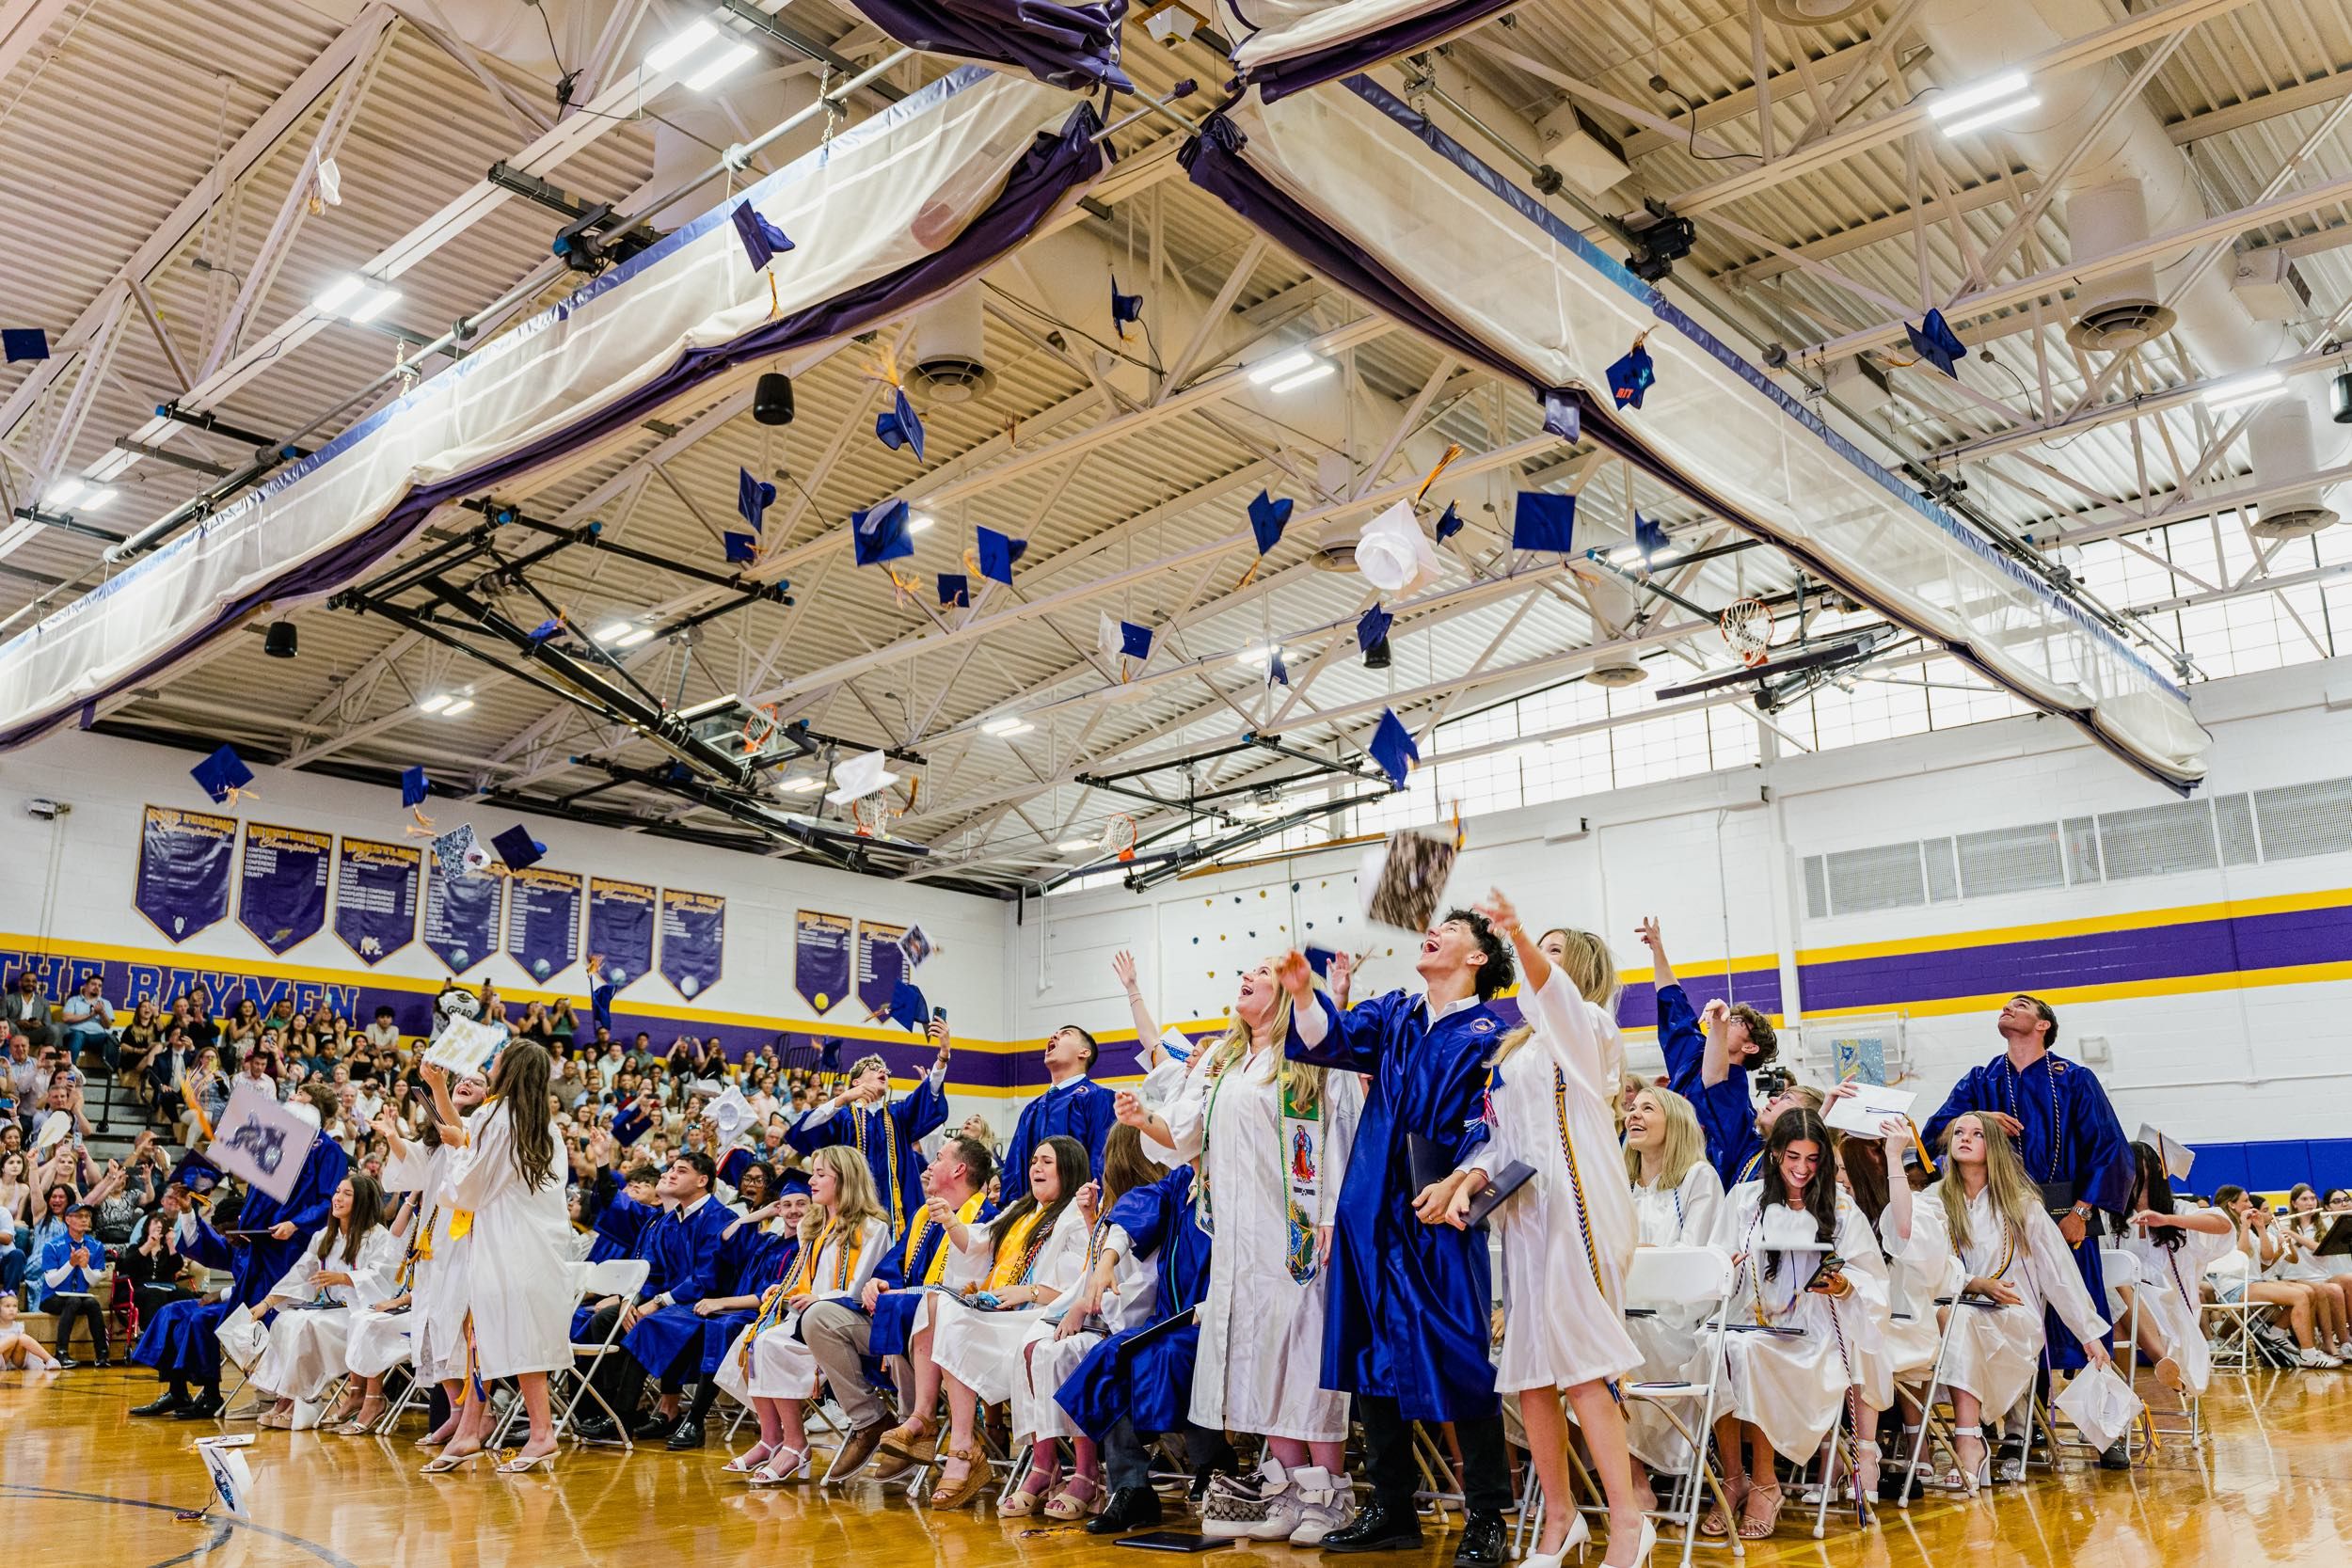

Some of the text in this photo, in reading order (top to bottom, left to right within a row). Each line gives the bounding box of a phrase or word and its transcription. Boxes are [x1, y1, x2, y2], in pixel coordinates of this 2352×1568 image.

[259, 836, 321, 855] Champions
[343, 839, 421, 863] WRESTLING
[352, 850, 410, 868] Champions
[0, 949, 360, 1031] THE BAYMEN
[447, 1006, 473, 1020] GRAD
